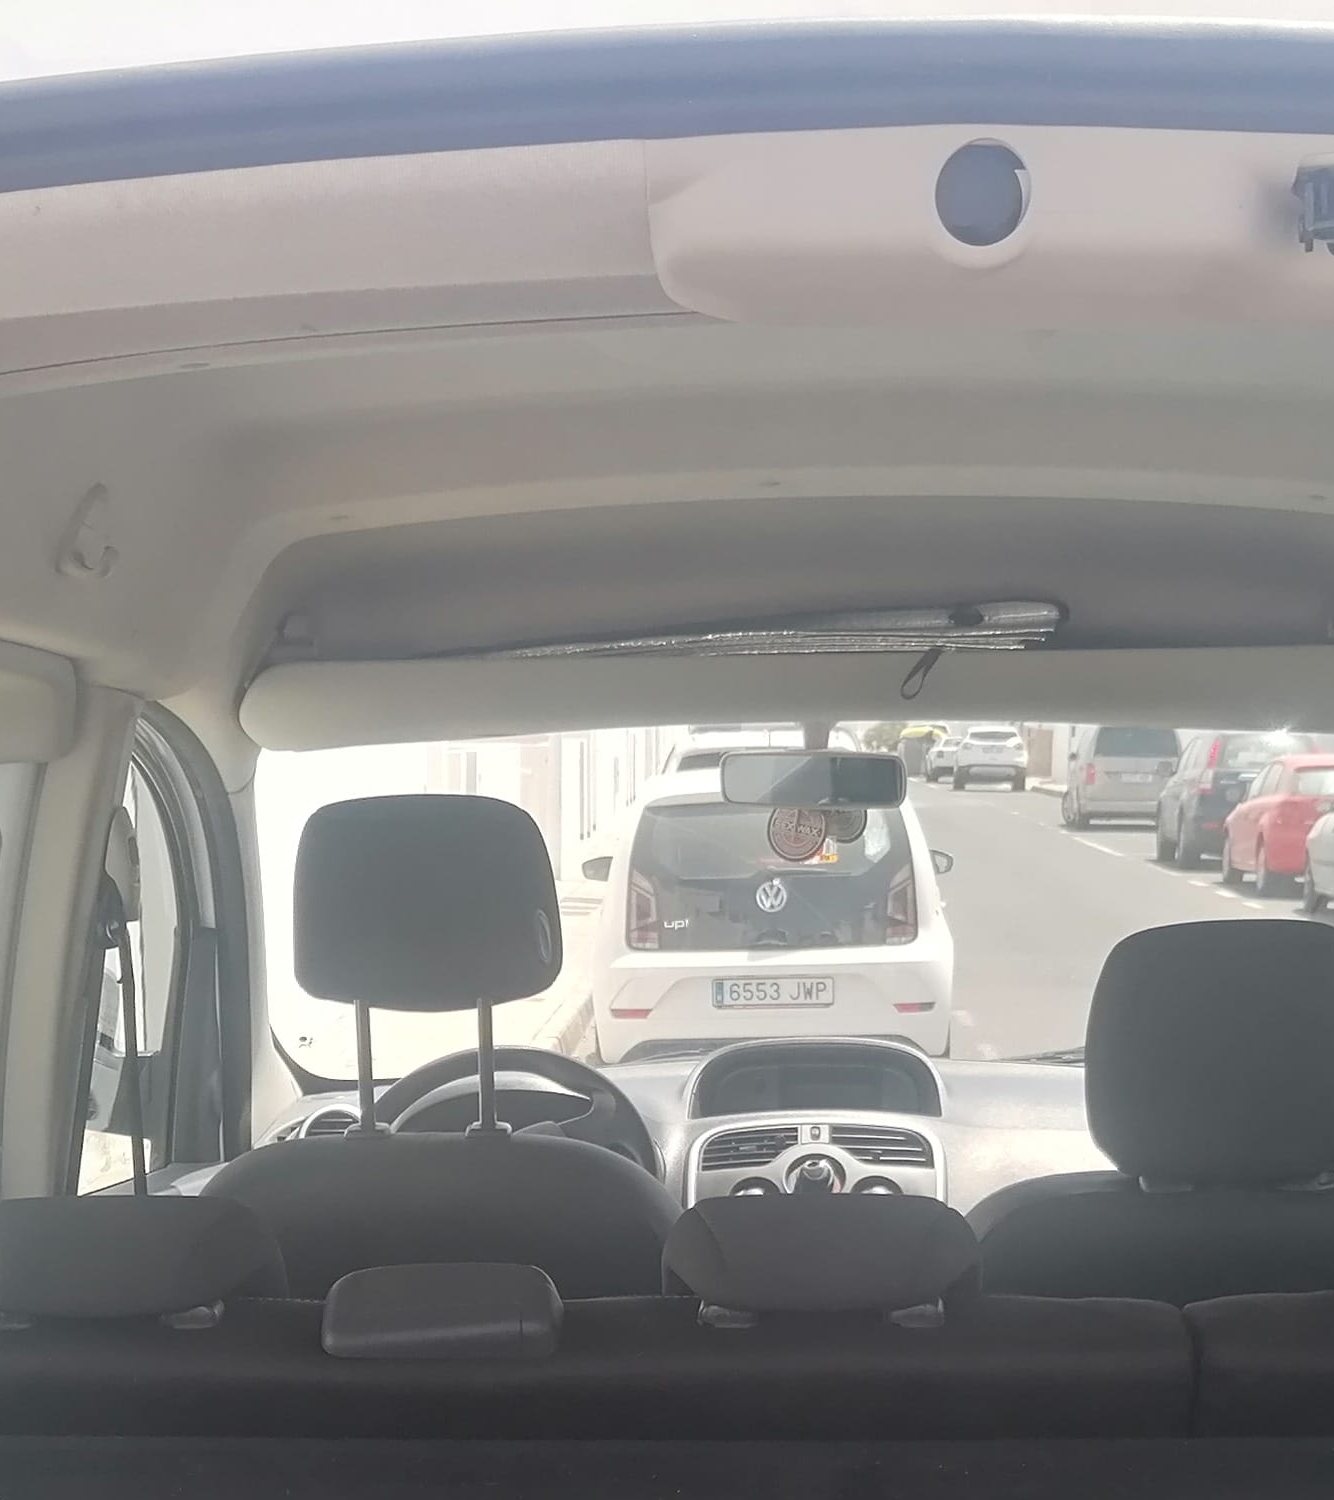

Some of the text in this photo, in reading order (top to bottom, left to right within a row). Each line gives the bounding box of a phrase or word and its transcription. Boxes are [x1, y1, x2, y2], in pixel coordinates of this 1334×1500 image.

[797, 824, 818, 836] WAX
[729, 981, 827, 1001] 6553 JWP
